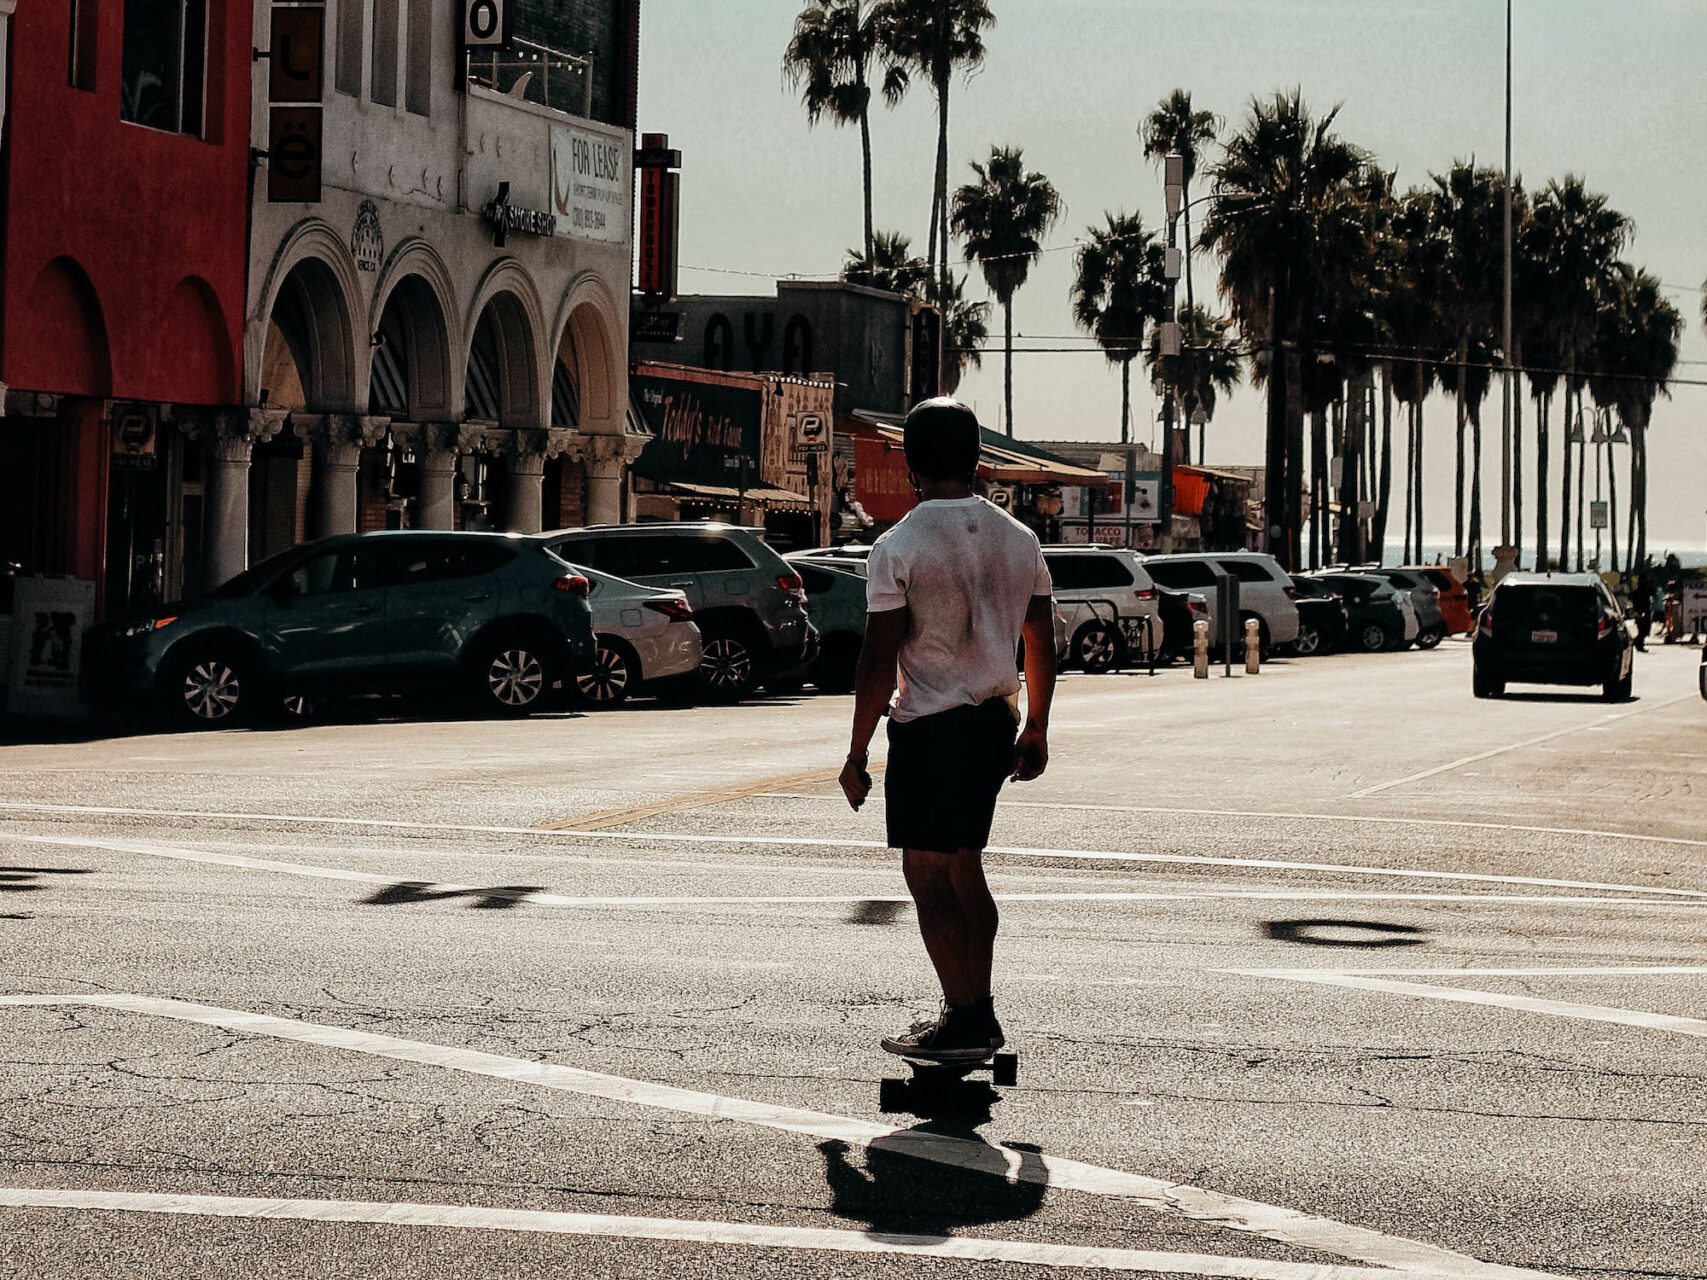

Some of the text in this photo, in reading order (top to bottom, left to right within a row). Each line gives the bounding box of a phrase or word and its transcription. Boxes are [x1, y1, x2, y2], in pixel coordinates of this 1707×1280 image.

[572, 137, 590, 175] FOR
[592, 143, 620, 182] LEASE
[509, 205, 536, 232] SMOKE
[536, 212, 557, 237] SHOP
[1075, 527, 1121, 536] TOACCO
